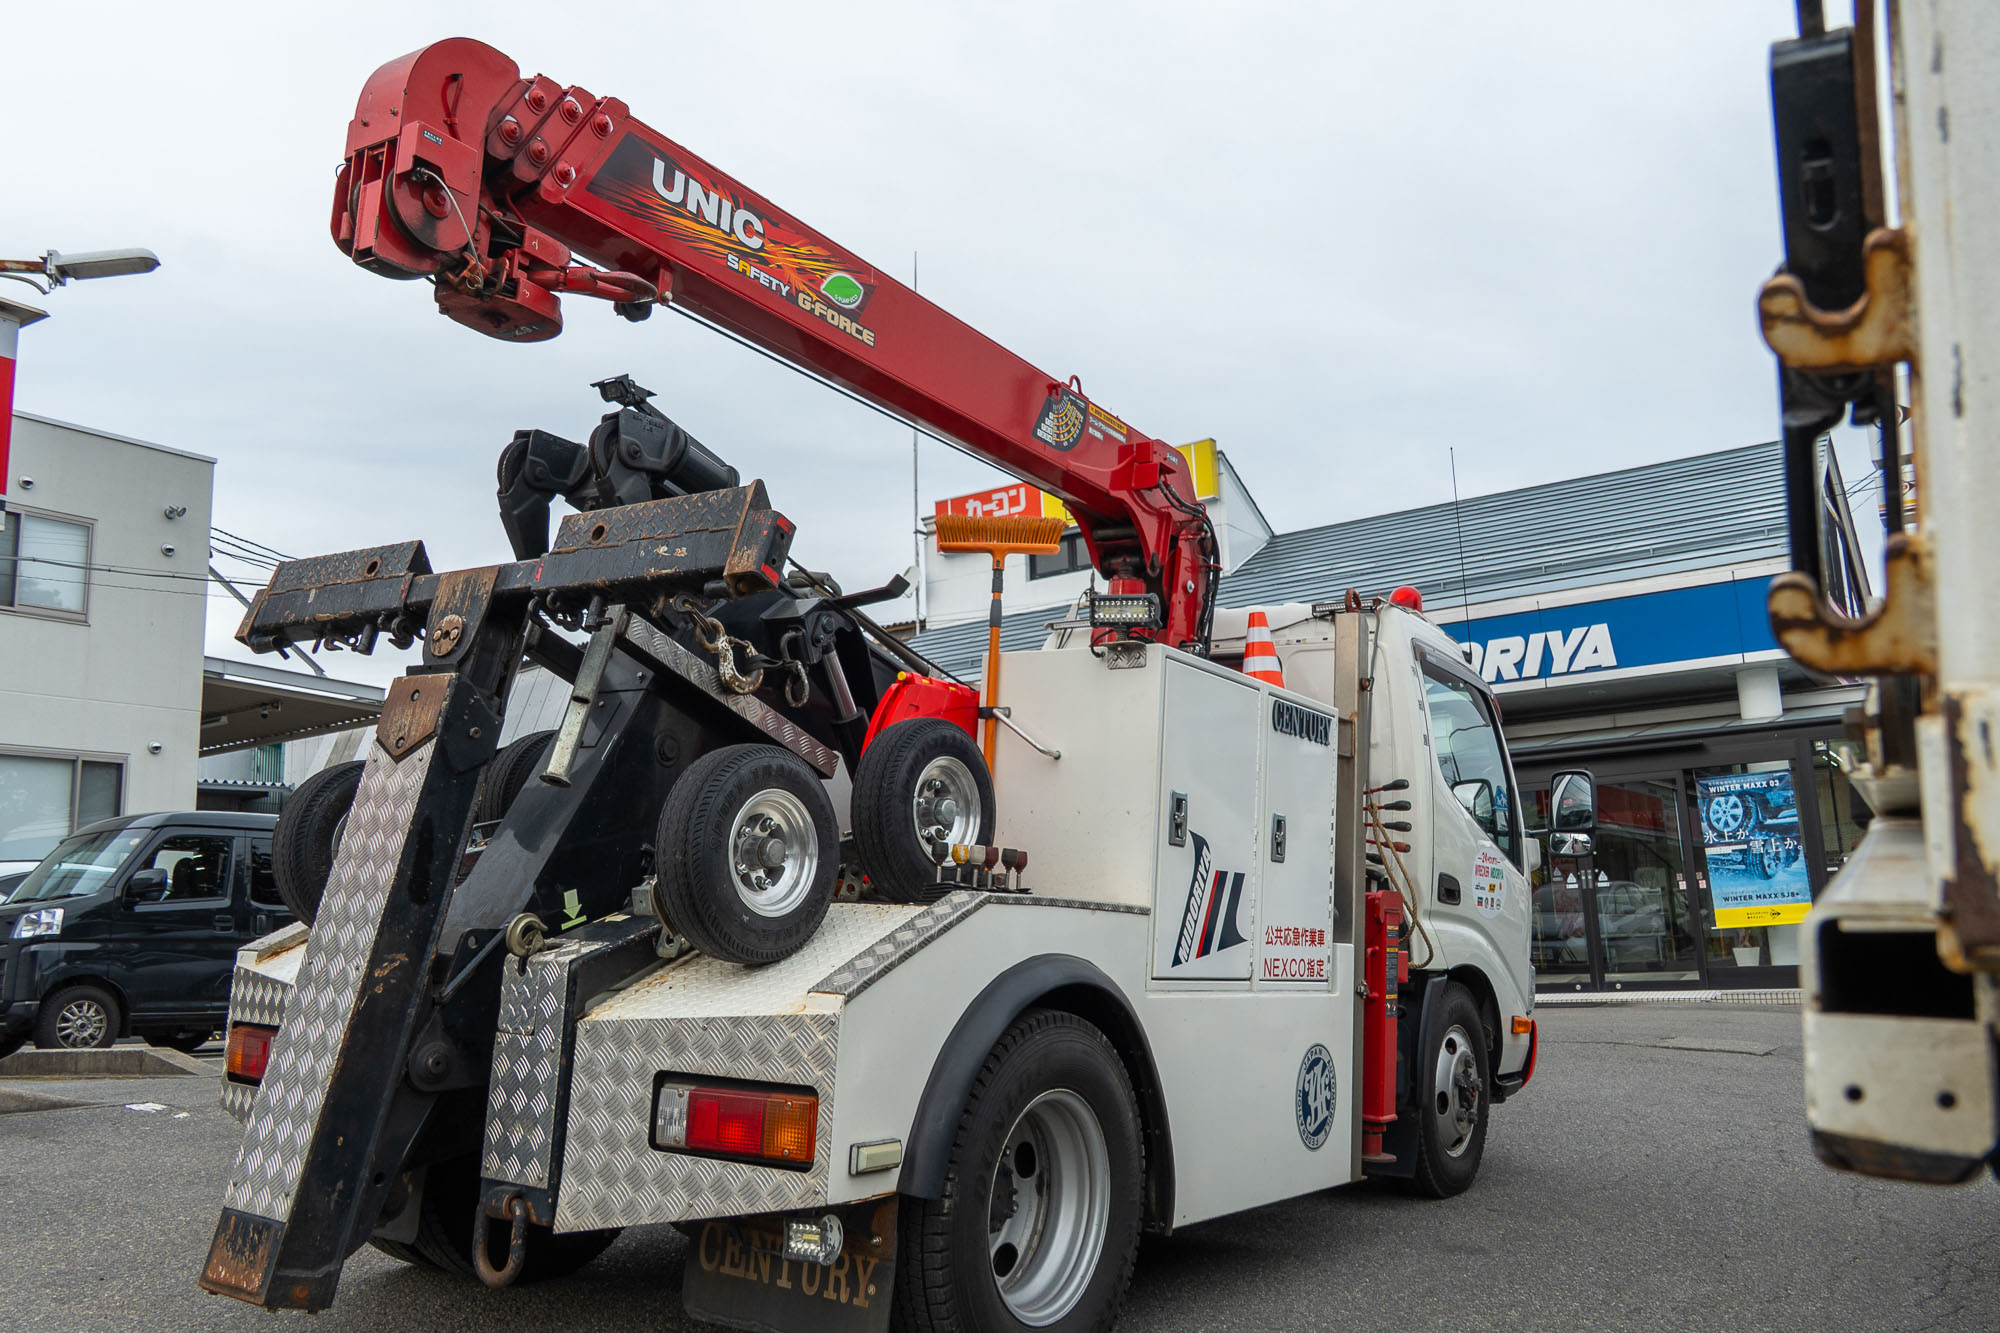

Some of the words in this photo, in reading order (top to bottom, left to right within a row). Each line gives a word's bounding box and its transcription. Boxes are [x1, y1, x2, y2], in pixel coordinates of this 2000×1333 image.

[652, 157, 765, 249] UNIC
[727, 253, 791, 297] SAFETY
[1272, 699, 1333, 747] CENTURY
[1708, 784, 1741, 794] WINTER
[1743, 780, 1768, 790] MAXX
[1769, 779, 1780, 787] 03
[1703, 829, 1754, 844] 氷上か、
[1749, 837, 1803, 854] 雪上か。
[1178, 845, 1212, 963] MIDORIYA
[1723, 894, 1754, 902] WINTER
[1756, 892, 1779, 900] MAXX
[1265, 925, 1325, 947] 公共応急作業車
[1263, 957, 1324, 978] NEXCO指定
[1303, 1047, 1323, 1071] JAPAN
